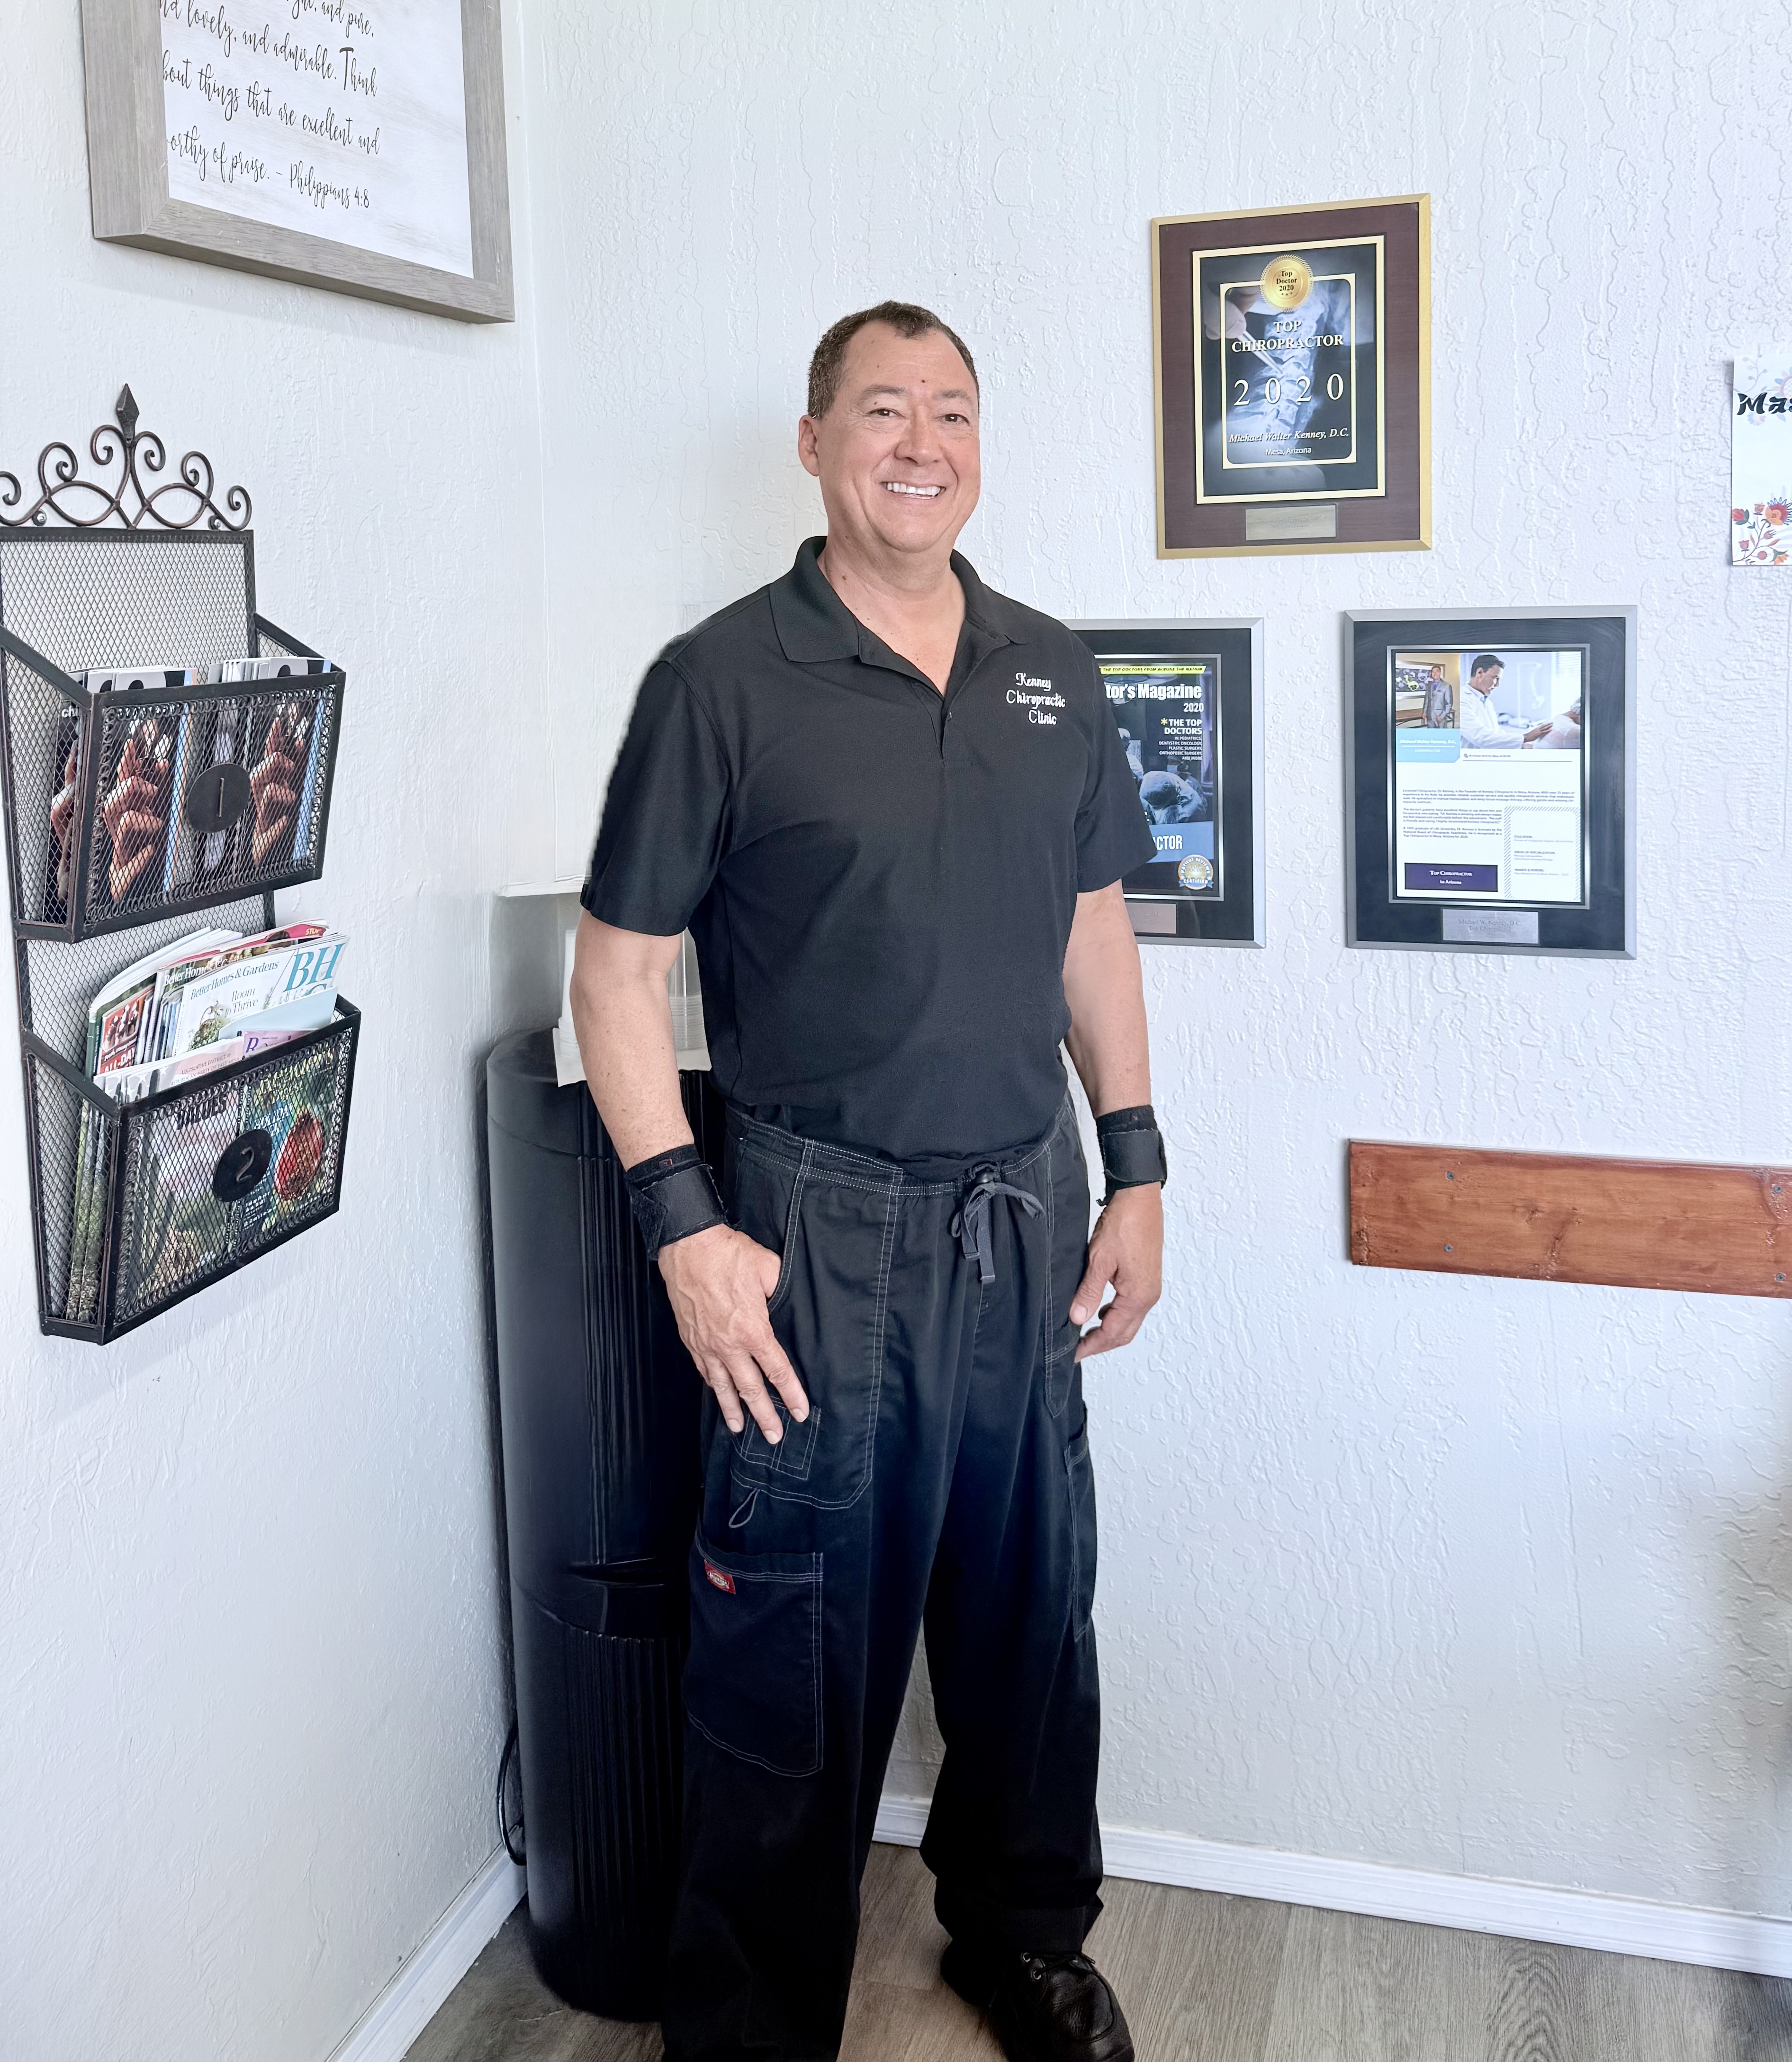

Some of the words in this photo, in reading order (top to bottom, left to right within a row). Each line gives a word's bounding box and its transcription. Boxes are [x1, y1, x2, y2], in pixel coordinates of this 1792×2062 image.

[346, 12, 373, 38] pure,
[159, 0, 182, 19] nd
[188, 0, 236, 58] lovely,
[243, 24, 270, 54] and
[274, 33, 336, 80] admirable.
[339, 47, 378, 97] Think
[162, 50, 192, 89] bout
[198, 63, 240, 121] things
[246, 81, 273, 117] that
[279, 103, 297, 126] are
[303, 107, 354, 146] excellent
[358, 127, 380, 154] and
[167, 126, 209, 181] orthy
[213, 142, 227, 183] of
[229, 151, 269, 183] praise.
[289, 160, 351, 209] Philippians
[354, 186, 369, 208] 4:8
[1273, 320, 1302, 333] TOP
[1232, 334, 1344, 352] CHIROPRACTOR
[1737, 392, 1792, 415] Ma
[1229, 432, 1262, 443] Michael
[1265, 432, 1292, 441] Walter
[1294, 430, 1327, 440] Kenney,
[1329, 428, 1349, 437] D.C.
[1015, 672, 1052, 692] Kenney
[1105, 684, 1136, 700] tor's
[1137, 683, 1203, 701] Magazine
[1006, 689, 1066, 710] Chiropractic
[1183, 702, 1204, 712] 2020
[1028, 710, 1057, 725] Clinic
[282, 943, 346, 993] BH
[163, 971, 185, 987] Better
[190, 983, 212, 1000] Better
[211, 972, 234, 990] Homes
[234, 967, 242, 979] &
[243, 961, 280, 977] Gardens
[231, 988, 255, 1002] Room
[224, 1006, 232, 1018] to
[233, 999, 258, 1015] Thrive
[181, 1061, 207, 1075] LEGISLATIVE
[207, 1054, 227, 1065] DISTRICT
[236, 1147, 254, 1182] 2
